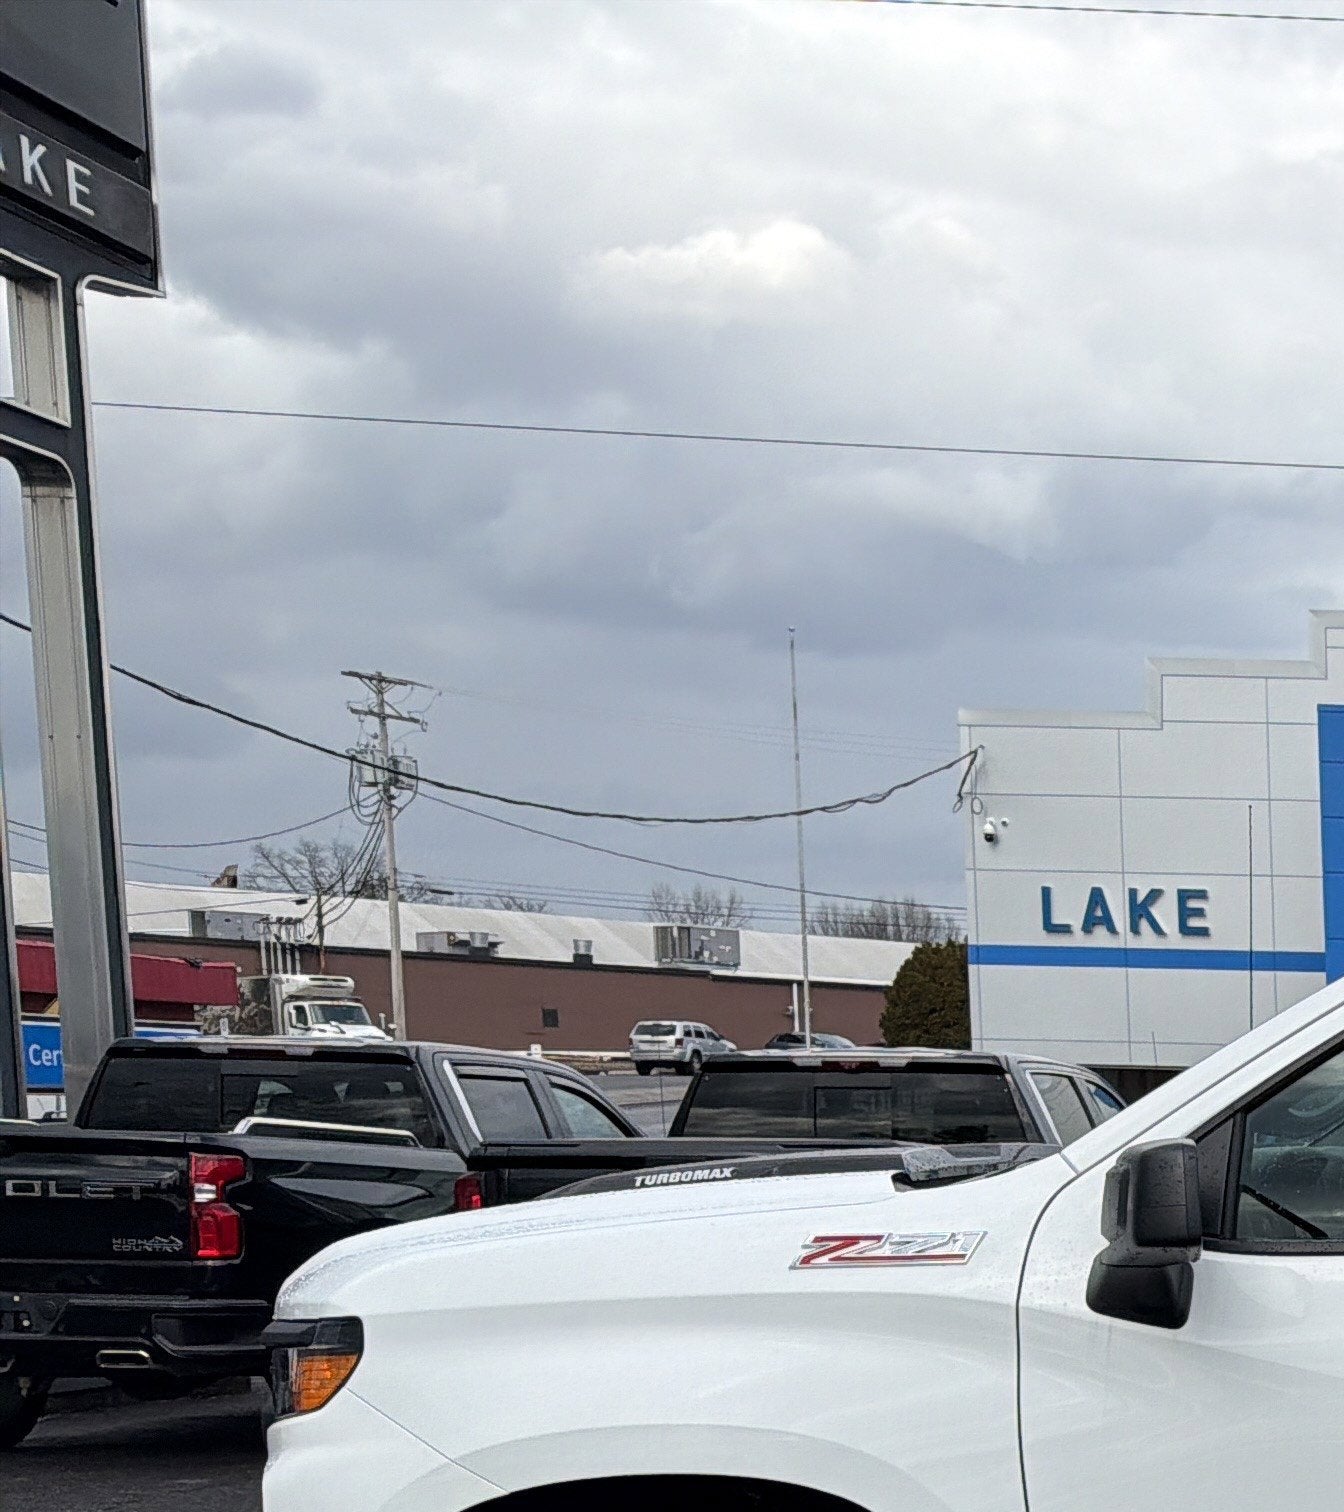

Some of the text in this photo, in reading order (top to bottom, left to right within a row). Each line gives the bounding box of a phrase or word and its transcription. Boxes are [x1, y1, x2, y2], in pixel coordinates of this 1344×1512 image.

[0, 133, 95, 216] KE
[1041, 886, 1211, 936] LAKE
[28, 1043, 63, 1066] Cer
[634, 1167, 737, 1187] TURBOMAX
[789, 1231, 988, 1270] Z71
